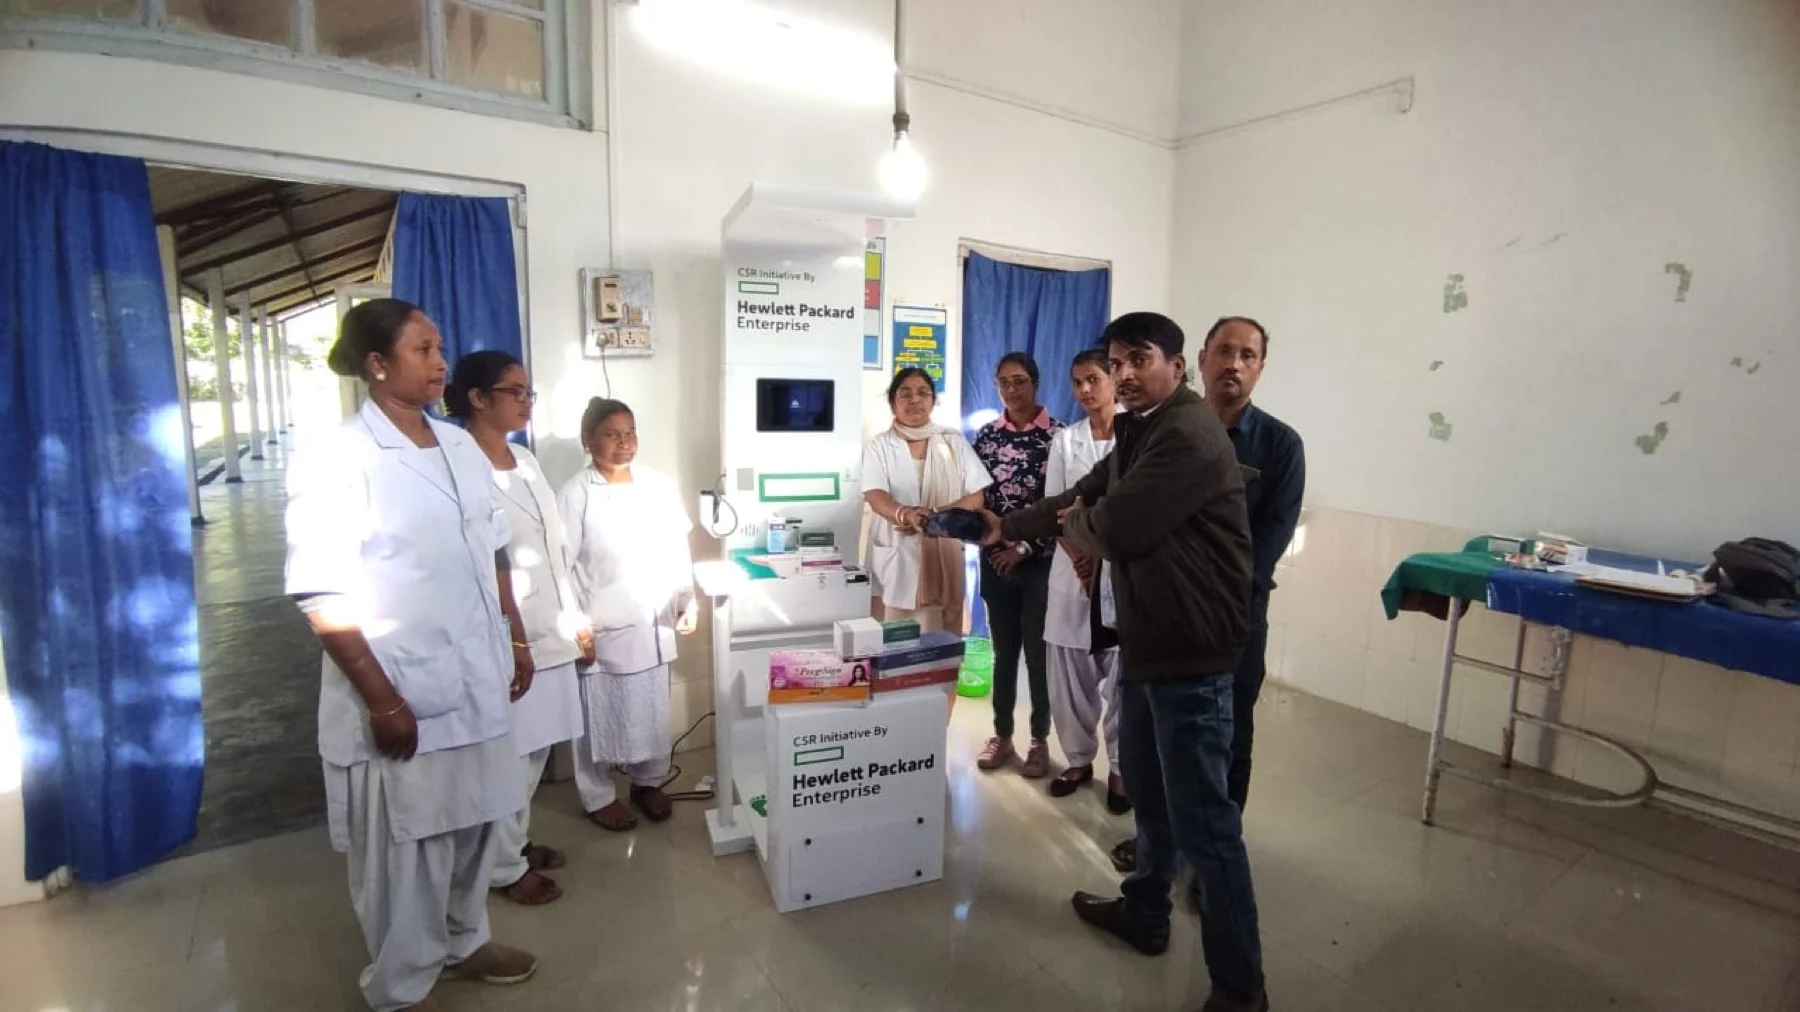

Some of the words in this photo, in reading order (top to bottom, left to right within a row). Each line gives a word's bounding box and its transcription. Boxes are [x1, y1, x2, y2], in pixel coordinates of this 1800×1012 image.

[737, 267, 757, 277] CSR
[760, 269, 801, 281] Initiative
[804, 272, 815, 283] By
[737, 300, 796, 316] Hewlett
[800, 303, 855, 319] Packard
[737, 316, 811, 333] Enterprise
[793, 734, 817, 747] CSR
[820, 728, 871, 744] Initiative
[874, 725, 888, 738] By
[792, 766, 864, 790] Hewlett
[868, 754, 935, 777] Packard
[792, 783, 882, 808] Enterprise
